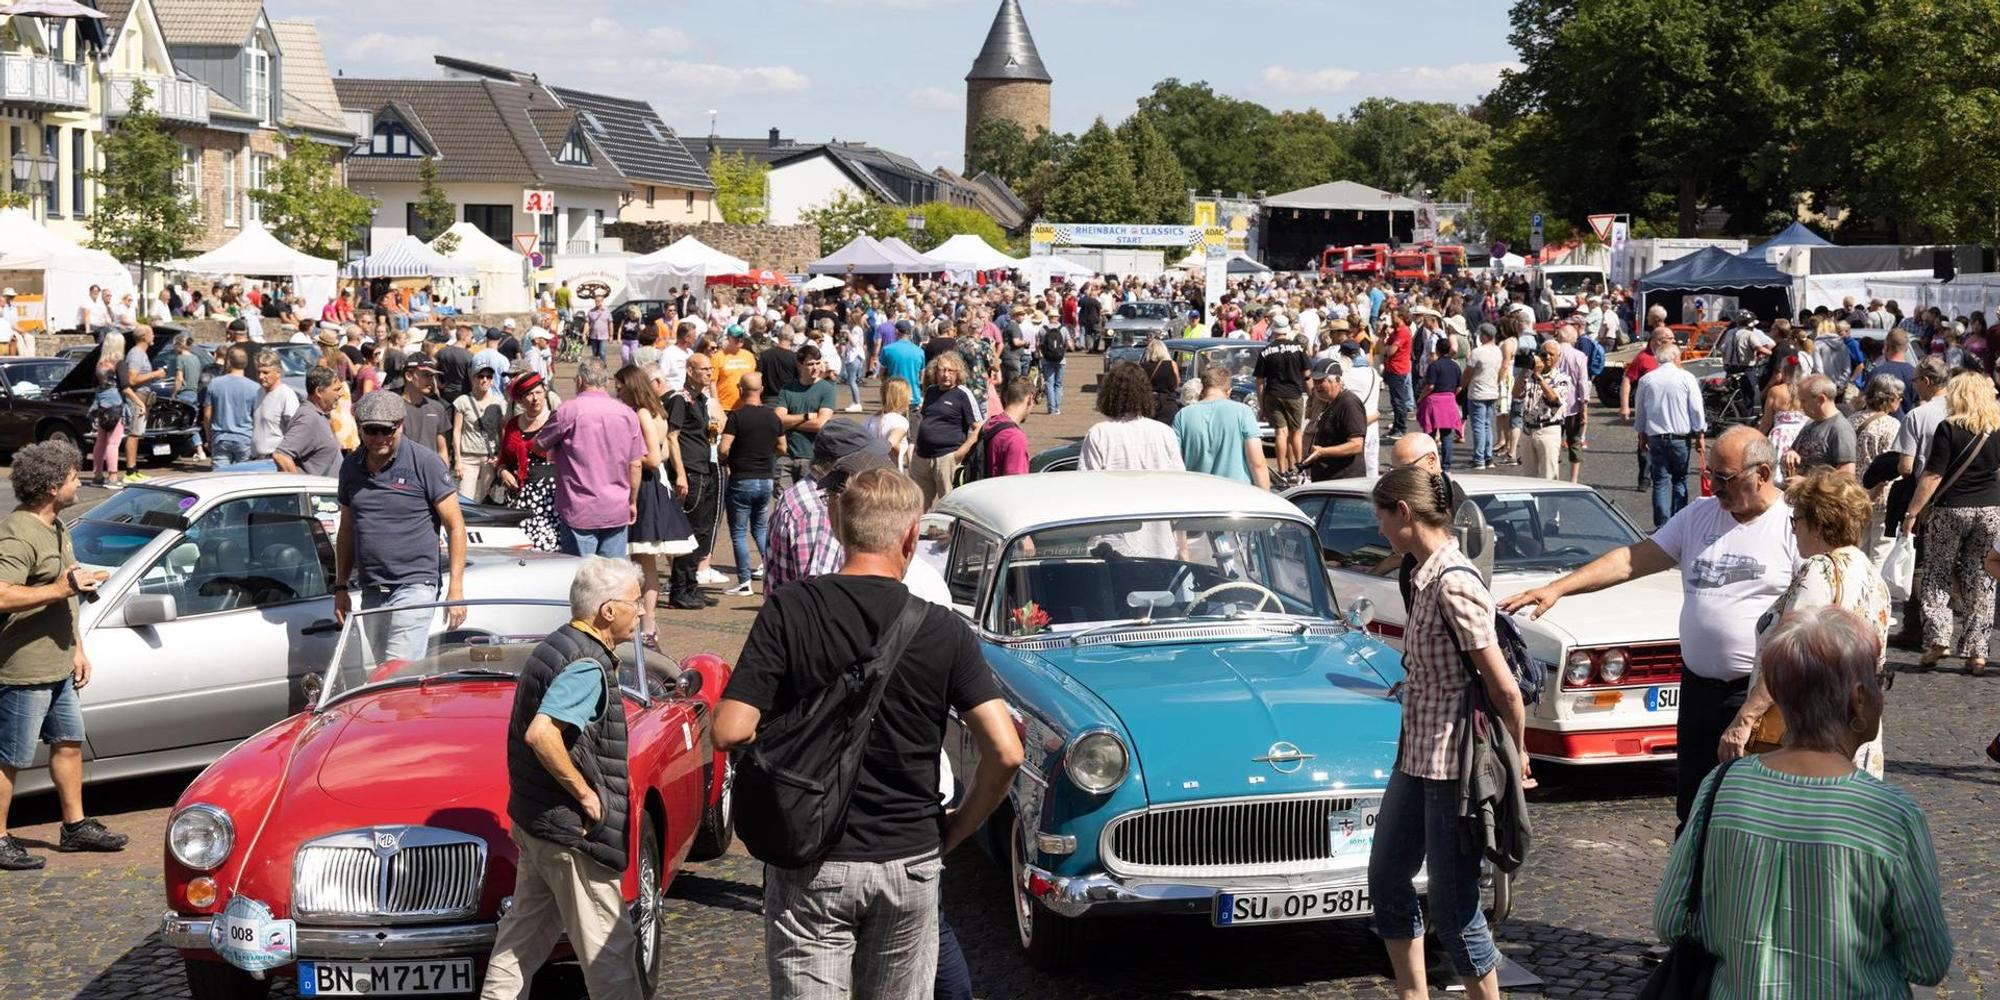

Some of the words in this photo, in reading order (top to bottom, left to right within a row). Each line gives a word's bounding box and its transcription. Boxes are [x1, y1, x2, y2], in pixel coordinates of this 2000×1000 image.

[1034, 226, 1055, 234] ADAC
[1075, 226, 1127, 235] RHEINBACH
[1140, 227, 1185, 236] CLASSICS
[1204, 228, 1225, 236] ADAC
[1116, 236, 1143, 244] START
[1659, 689, 1678, 707] SU
[380, 834, 394, 847] MG
[1233, 894, 1268, 920] SU
[231, 926, 254, 942] 008
[317, 966, 354, 992] BN
